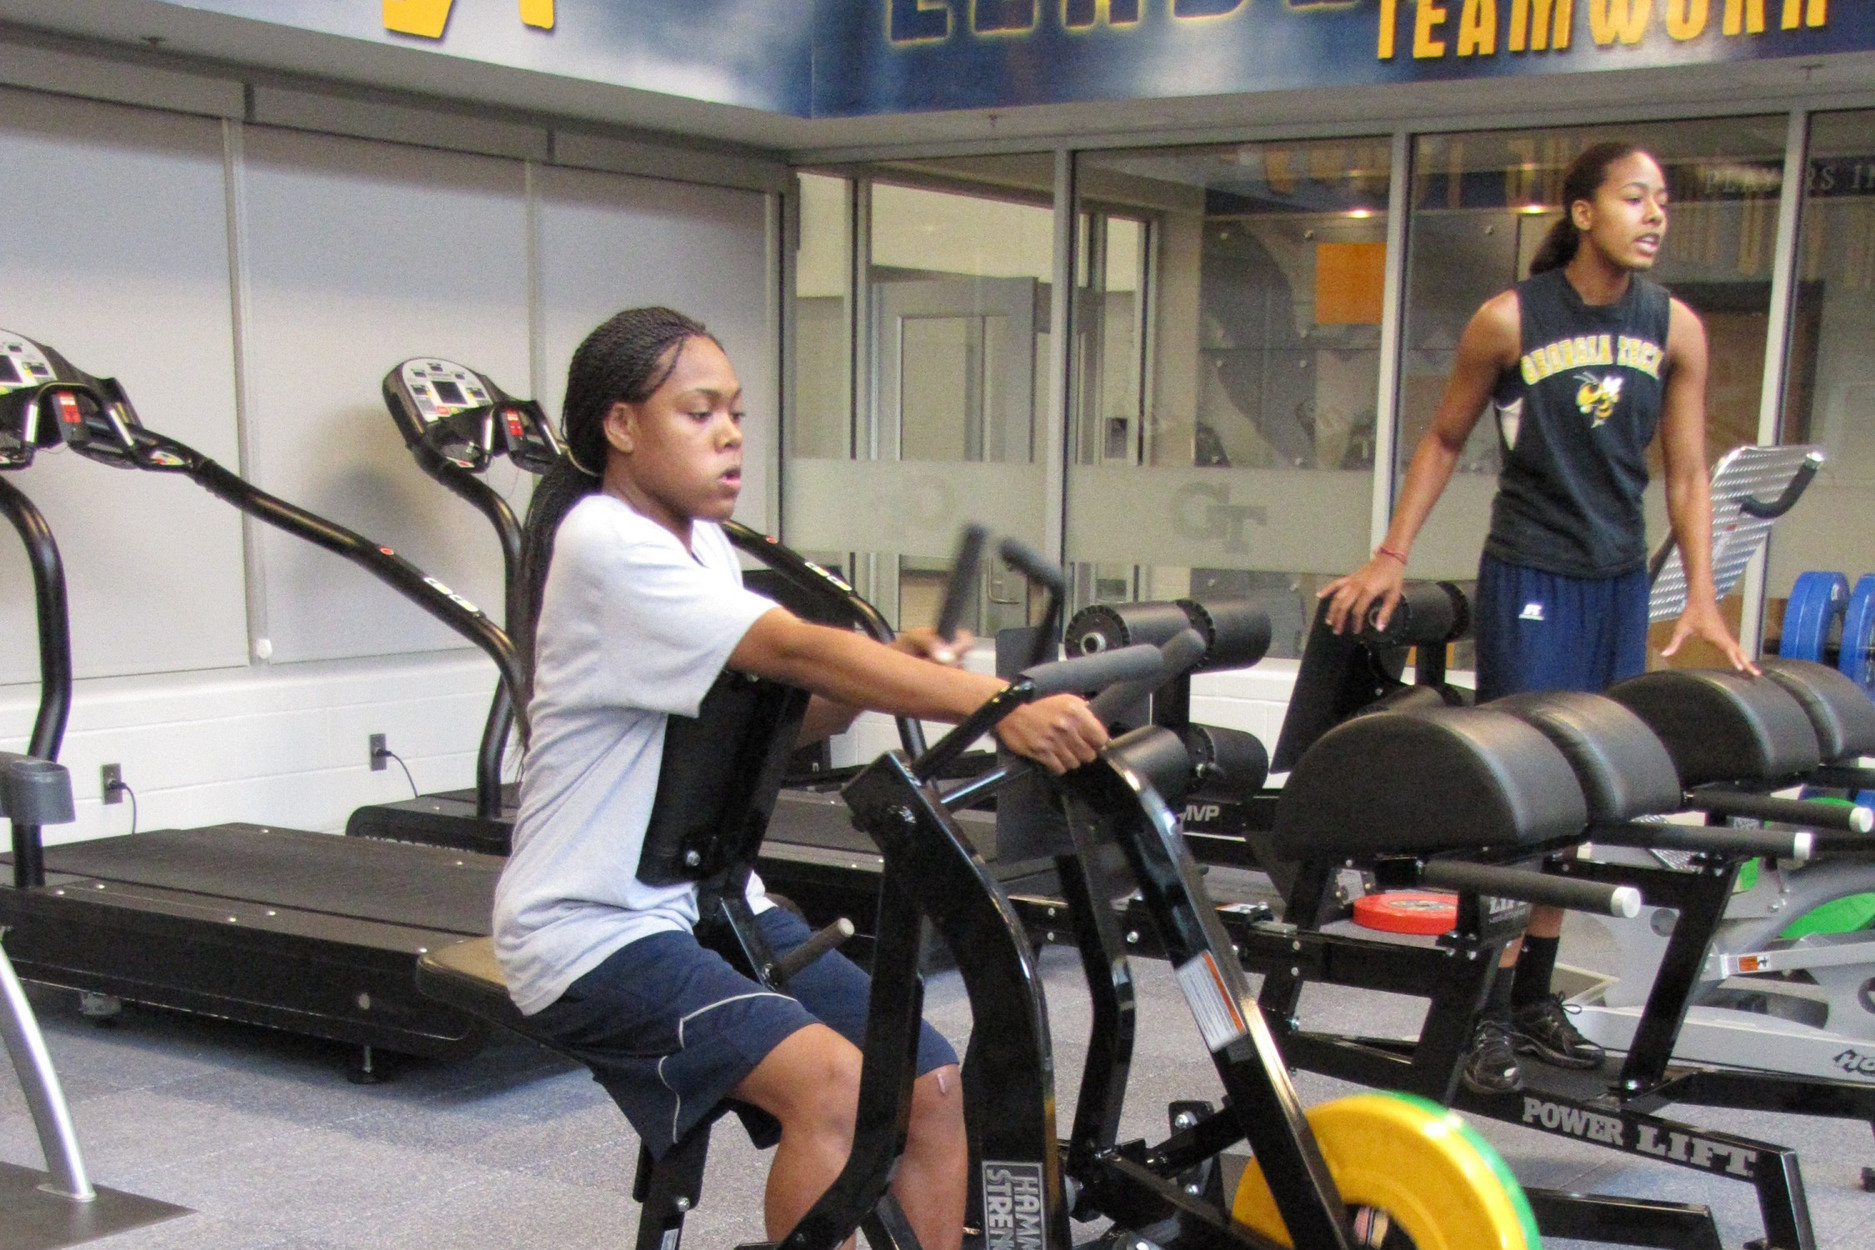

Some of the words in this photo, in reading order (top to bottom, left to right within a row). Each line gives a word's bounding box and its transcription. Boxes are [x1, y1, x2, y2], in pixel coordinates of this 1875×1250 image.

[1182, 804, 1220, 822] MVP
[1522, 1096, 1624, 1147] POWER
[1636, 1124, 1757, 1178] LIFT
